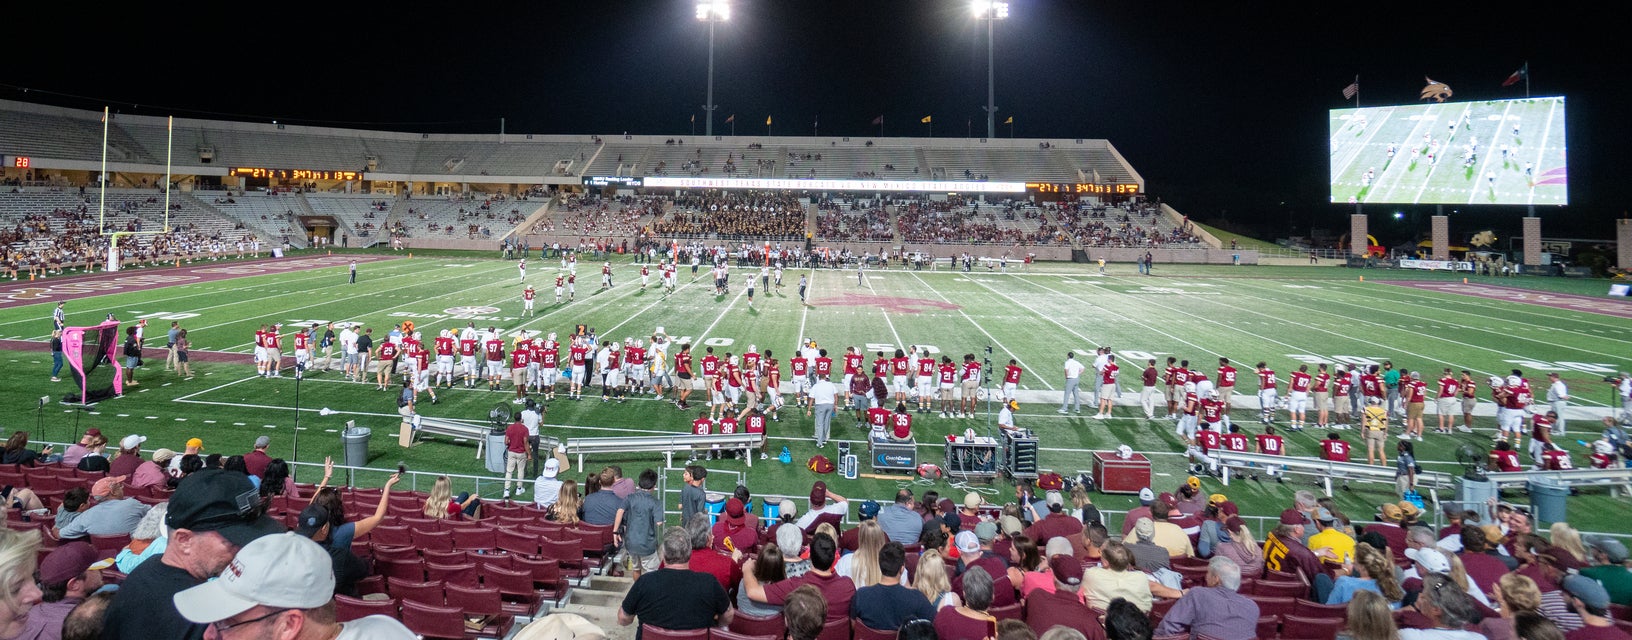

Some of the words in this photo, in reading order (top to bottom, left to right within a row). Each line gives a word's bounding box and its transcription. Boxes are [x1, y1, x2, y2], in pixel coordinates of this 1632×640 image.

[16, 157, 28, 168] 28
[254, 169, 266, 177] 27
[293, 170, 311, 179] 3:47
[334, 171, 343, 179] 13
[1039, 183, 1051, 192] 27
[1076, 183, 1094, 192] 3:47
[1116, 184, 1125, 193] 13
[578, 325, 585, 336] 2
[383, 346, 394, 355] 29
[442, 342, 448, 351] 4
[488, 343, 498, 353] 97
[865, 343, 941, 354] 50
[517, 354, 526, 364] 73
[544, 354, 556, 364] 22
[573, 352, 583, 361] 48
[634, 352, 640, 361] 3
[706, 361, 716, 371] 58
[794, 362, 804, 371] 86
[818, 361, 829, 371] 23
[850, 358, 860, 369] 90
[923, 363, 933, 373] 84
[879, 364, 887, 374] 14
[943, 371, 952, 380] 21
[1011, 372, 1018, 381] 2
[1297, 376, 1309, 388] 87
[750, 416, 763, 429] 88
[873, 413, 886, 425] 31
[896, 413, 909, 428] 35
[697, 423, 709, 436] 20
[721, 422, 734, 435] 38
[1207, 433, 1216, 446] 3
[1230, 436, 1245, 451] 13
[1264, 438, 1278, 451] 10
[1329, 441, 1344, 455] 15
